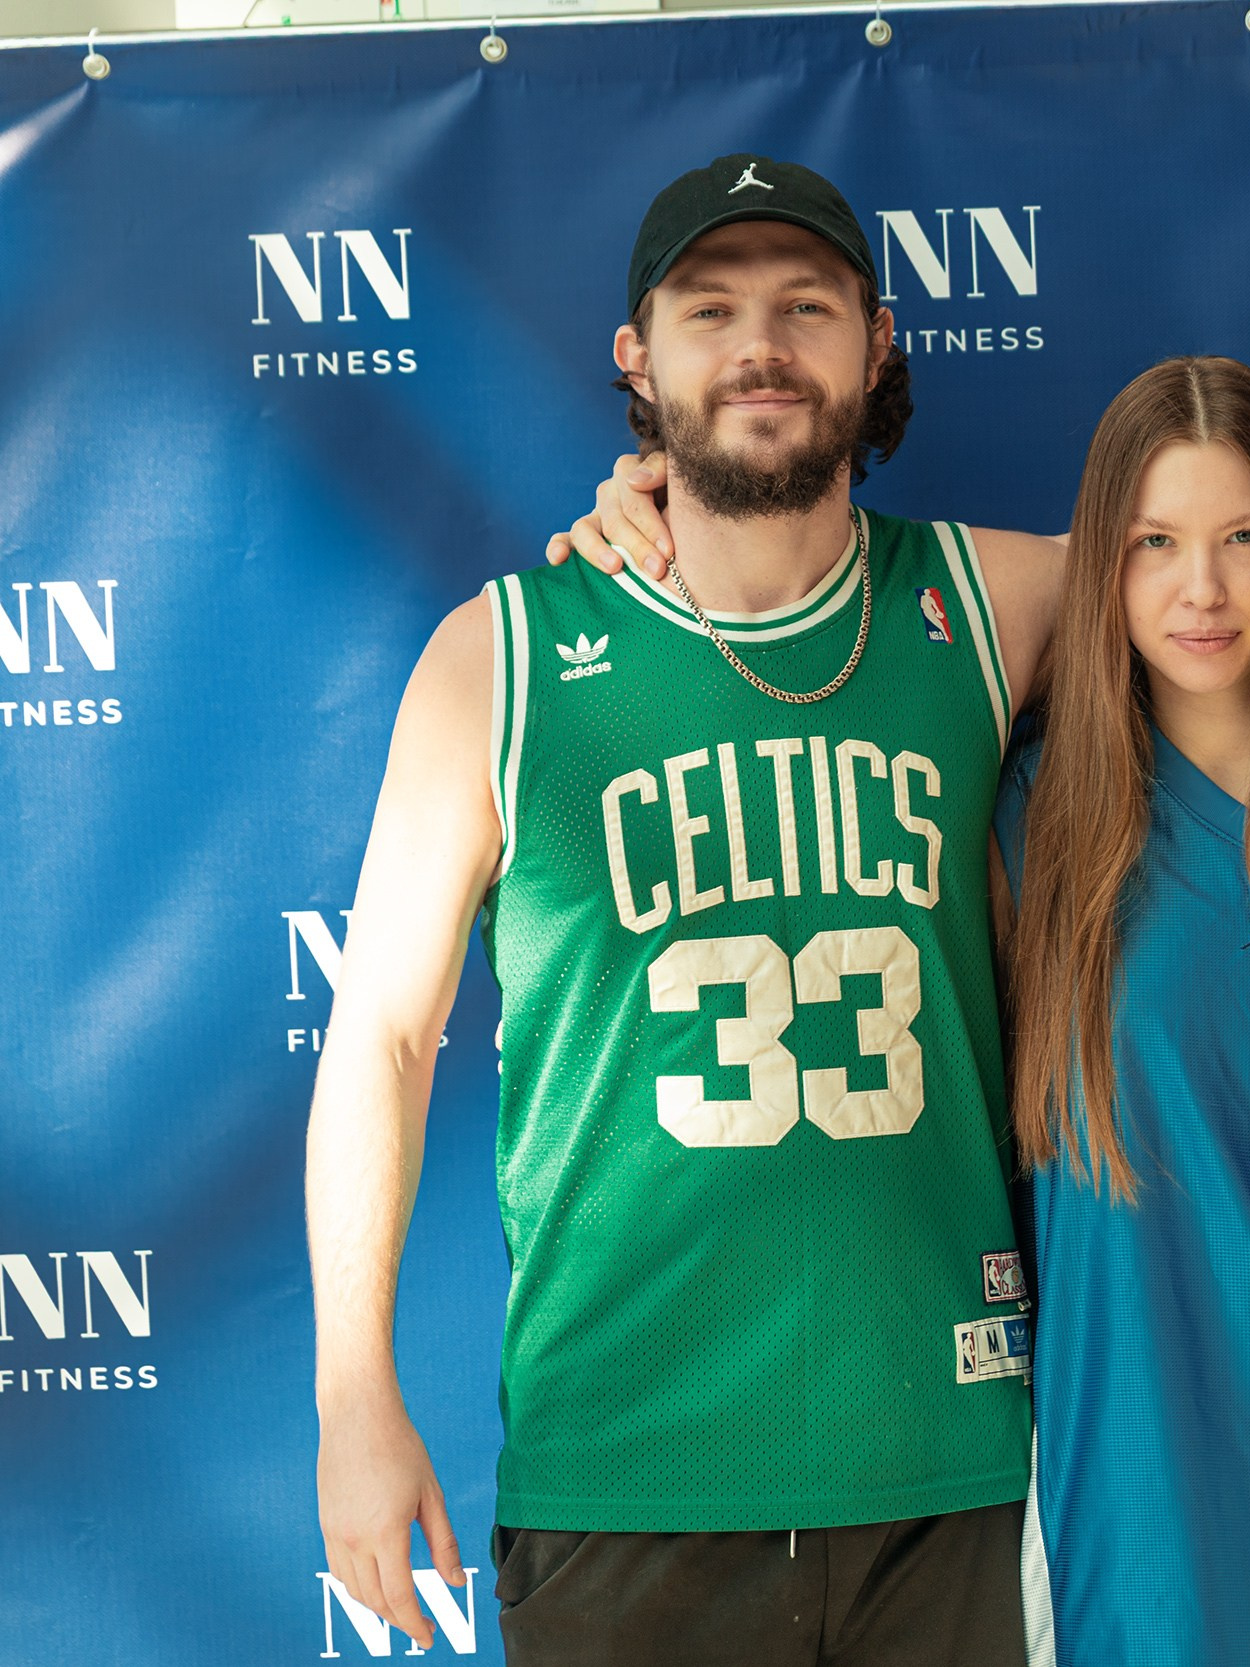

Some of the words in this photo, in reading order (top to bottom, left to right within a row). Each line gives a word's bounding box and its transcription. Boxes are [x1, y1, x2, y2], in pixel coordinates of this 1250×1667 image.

[249, 228, 412, 325] NN
[875, 204, 1042, 301] NN
[253, 348, 417, 379] FITNESS
[891, 326, 1045, 354] ITNESS
[929, 630, 945, 641] NBA
[560, 661, 612, 681] adidas
[0, 698, 123, 728] TNESS
[602, 736, 943, 935] CELTICS
[647, 926, 925, 1148] 33
[0, 1250, 153, 1341] NN
[986, 1328, 1000, 1354] M
[315, 1567, 479, 1658] NN
